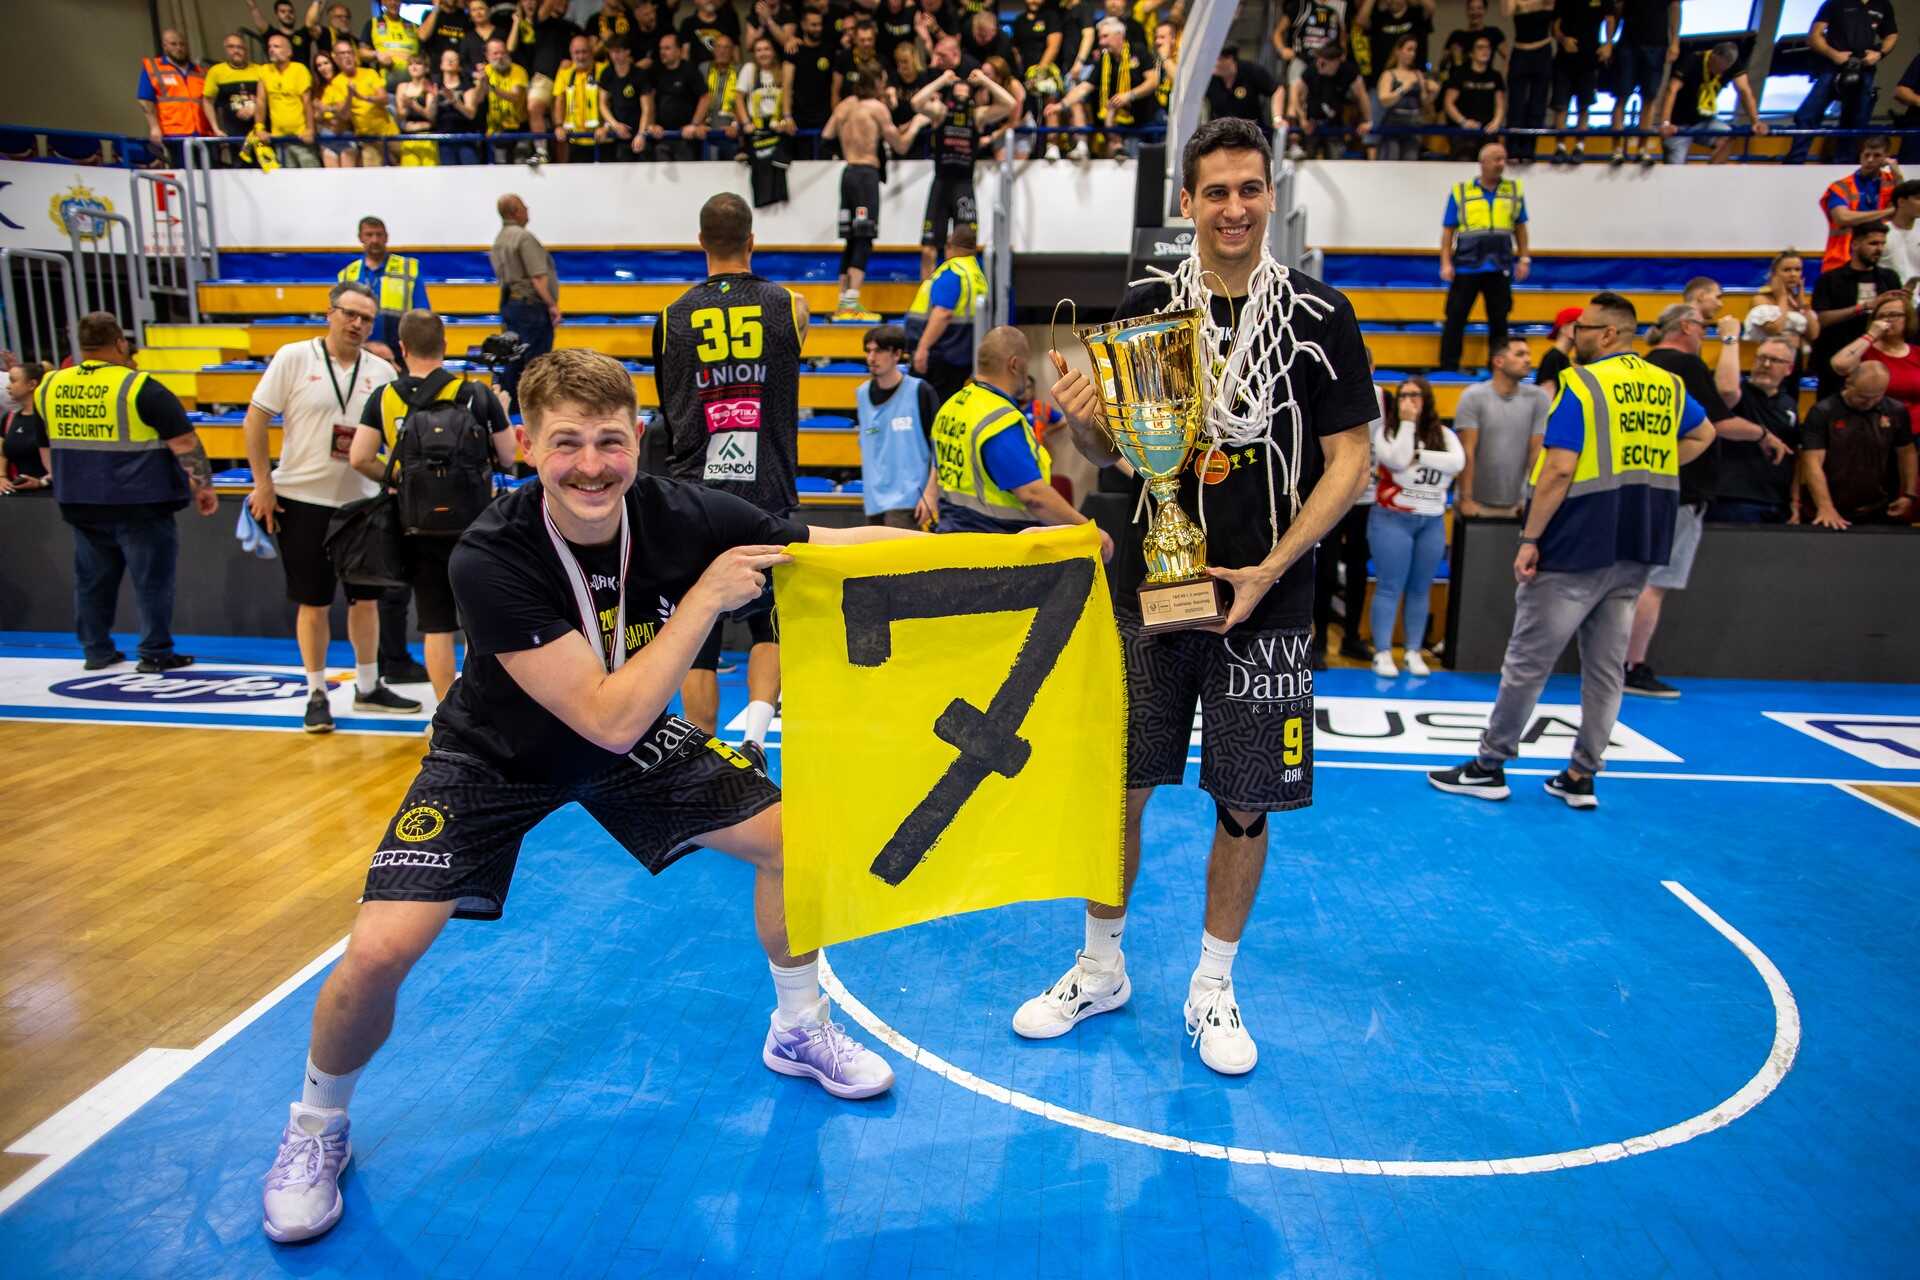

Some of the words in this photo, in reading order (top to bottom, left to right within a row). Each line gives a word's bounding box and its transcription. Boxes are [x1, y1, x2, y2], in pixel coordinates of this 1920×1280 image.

[690, 305, 763, 362] 35
[55, 385, 109, 400] CRUZ-COP
[696, 364, 767, 388] UNION
[57, 422, 114, 438] SECURITY
[841, 557, 1096, 887] 7
[1283, 717, 1303, 766] 9
